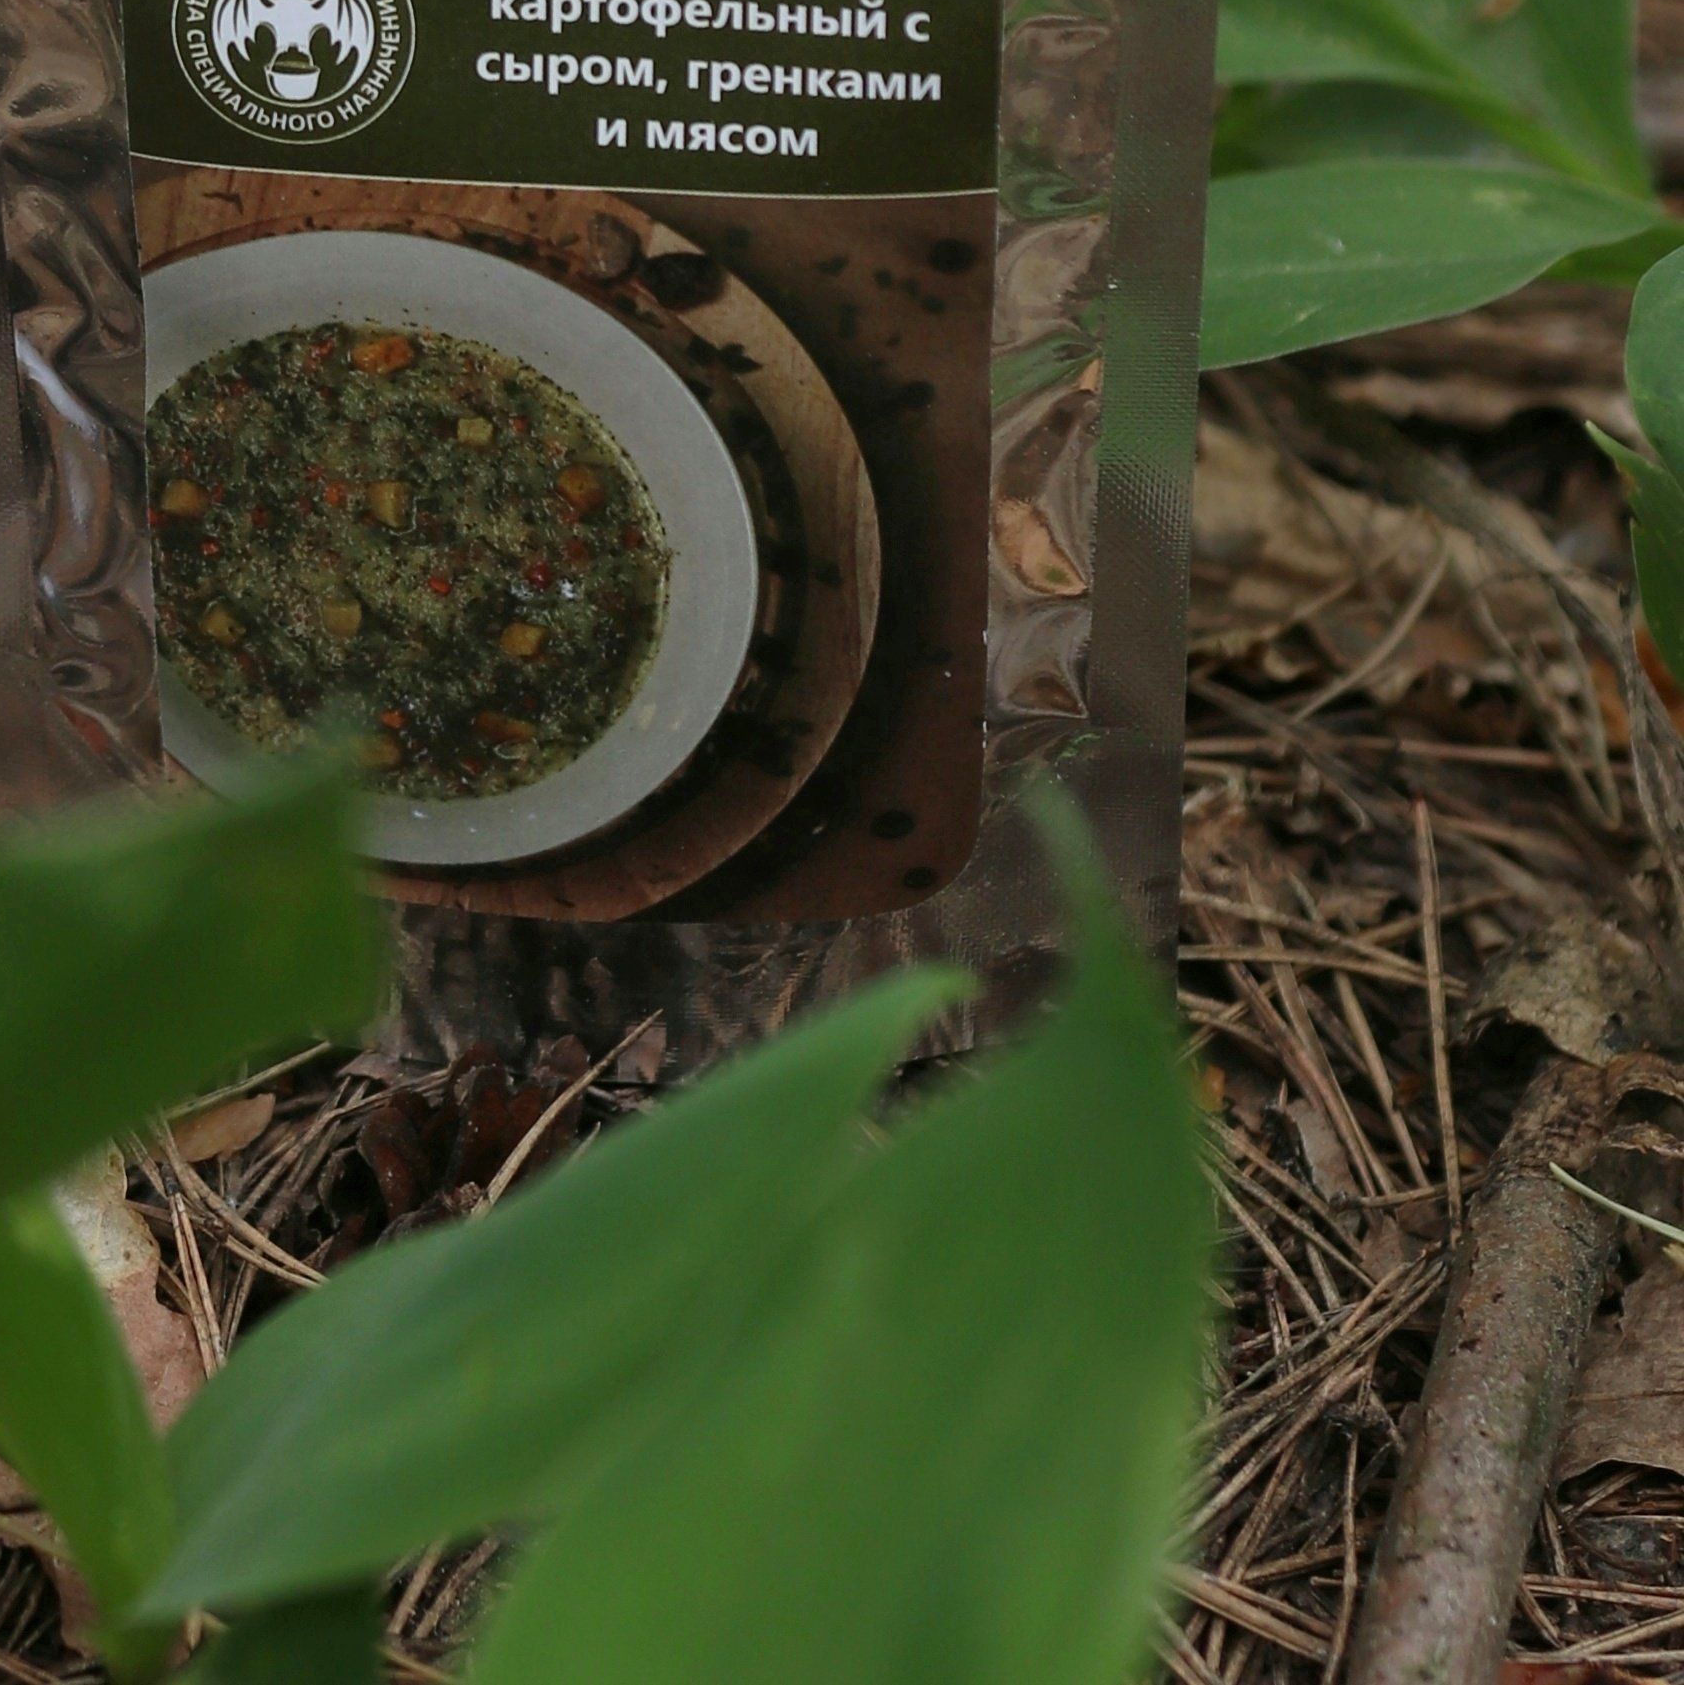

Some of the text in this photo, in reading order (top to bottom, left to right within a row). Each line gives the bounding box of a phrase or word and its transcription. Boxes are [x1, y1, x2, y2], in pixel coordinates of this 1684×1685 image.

[904, 11, 931, 42] с
[186, 29, 334, 132] СПЕЦИАЛЬНОГО
[475, 52, 942, 104] сыром, гренками
[596, 121, 818, 156] и мясом
